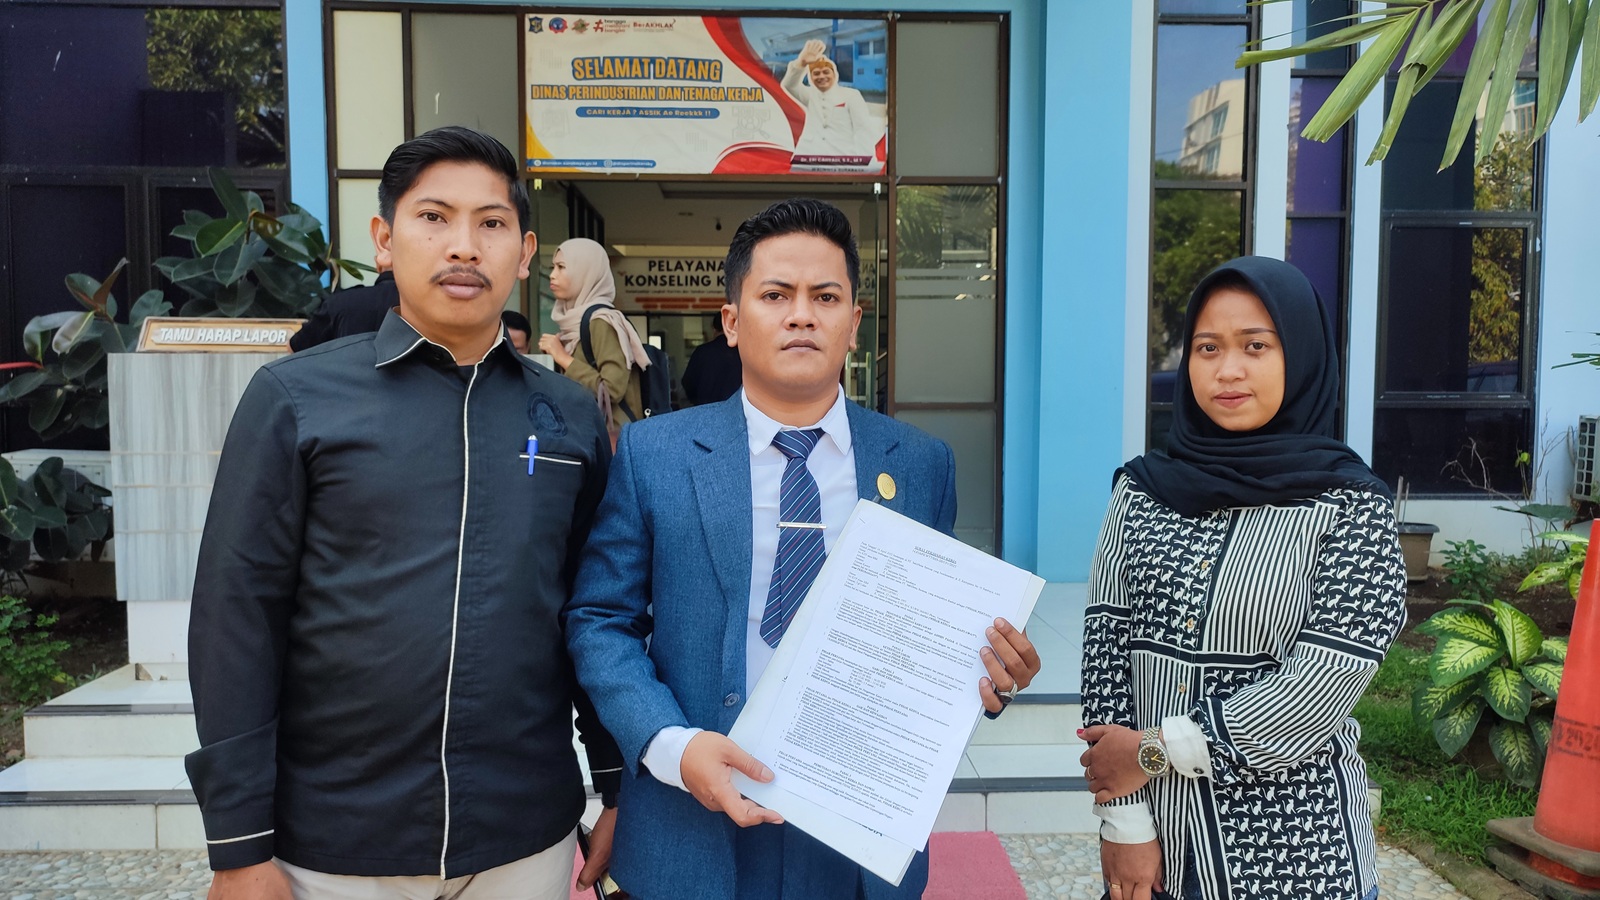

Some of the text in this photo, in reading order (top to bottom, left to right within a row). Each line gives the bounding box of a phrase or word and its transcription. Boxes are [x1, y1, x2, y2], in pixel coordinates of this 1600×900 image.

[572, 57, 722, 82] SELAMAT DATANG
[531, 85, 764, 102] DINAS PERINDUSTRIAN DAN TENAGA KERJA
[649, 261, 725, 272] PELAYANA
[625, 275, 712, 287] KONSELING
[160, 328, 287, 343] TAMU HARAP LAPOR
